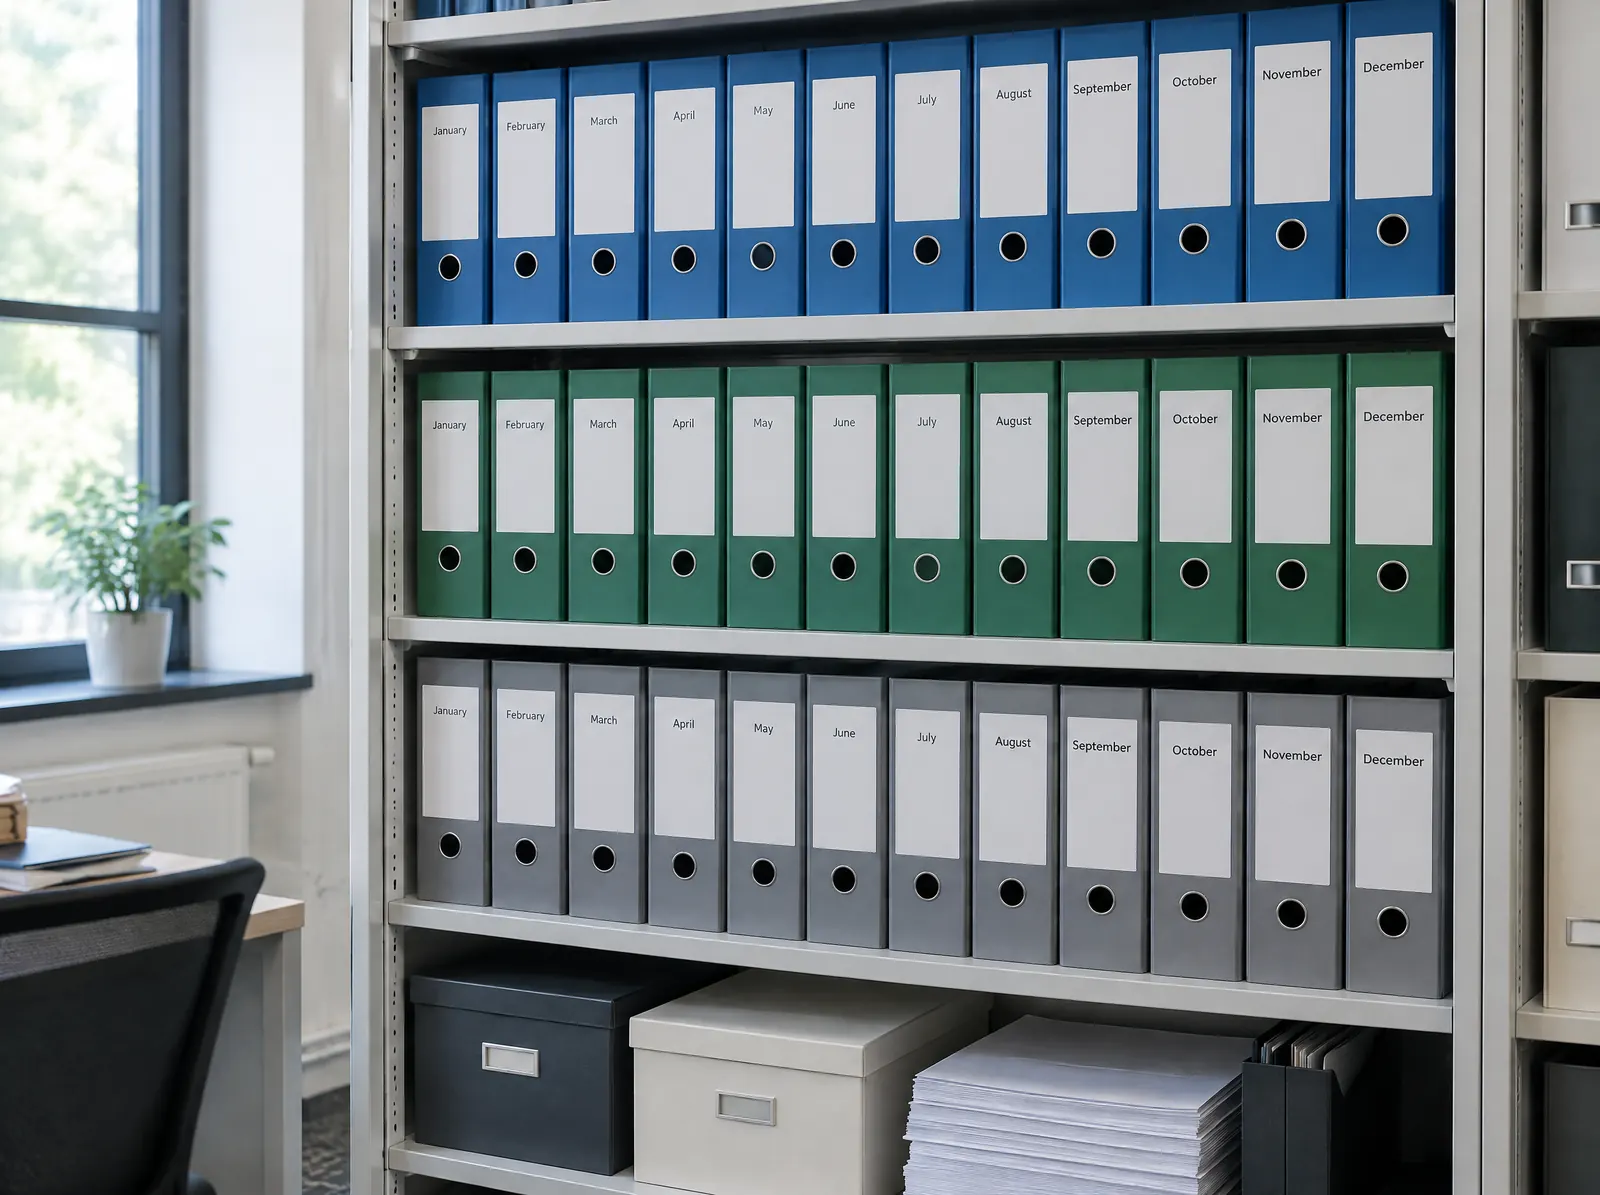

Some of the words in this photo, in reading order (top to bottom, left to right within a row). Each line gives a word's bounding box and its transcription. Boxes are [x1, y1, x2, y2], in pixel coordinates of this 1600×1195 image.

[1364, 58, 1424, 72] December
[1262, 66, 1322, 80] November
[1172, 74, 1218, 88] October
[1074, 80, 1132, 96] September
[918, 94, 938, 106] July
[996, 88, 1032, 102] August
[754, 106, 774, 116] May
[832, 100, 856, 110] June
[590, 116, 618, 126] March
[672, 110, 696, 122] April
[433, 124, 467, 136] January
[506, 122, 546, 132] February
[916, 416, 936, 428] July
[996, 416, 1032, 428] August
[1074, 414, 1132, 428] September
[1172, 414, 1218, 424] October
[1262, 412, 1322, 424] November
[1364, 410, 1424, 422] December
[433, 419, 467, 431] January
[506, 420, 544, 432] February
[590, 418, 616, 428] March
[672, 418, 694, 430] April
[754, 418, 774, 430] May
[832, 418, 856, 428] June
[433, 706, 467, 718] January
[506, 710, 546, 722] February
[590, 714, 618, 724] March
[672, 718, 694, 730] April
[754, 722, 774, 736] May
[832, 728, 856, 738] June
[916, 732, 936, 744] July
[994, 736, 1032, 750] August
[1072, 740, 1132, 754] September
[1172, 744, 1218, 756] October
[1264, 748, 1322, 762] November
[1364, 754, 1424, 766] December
